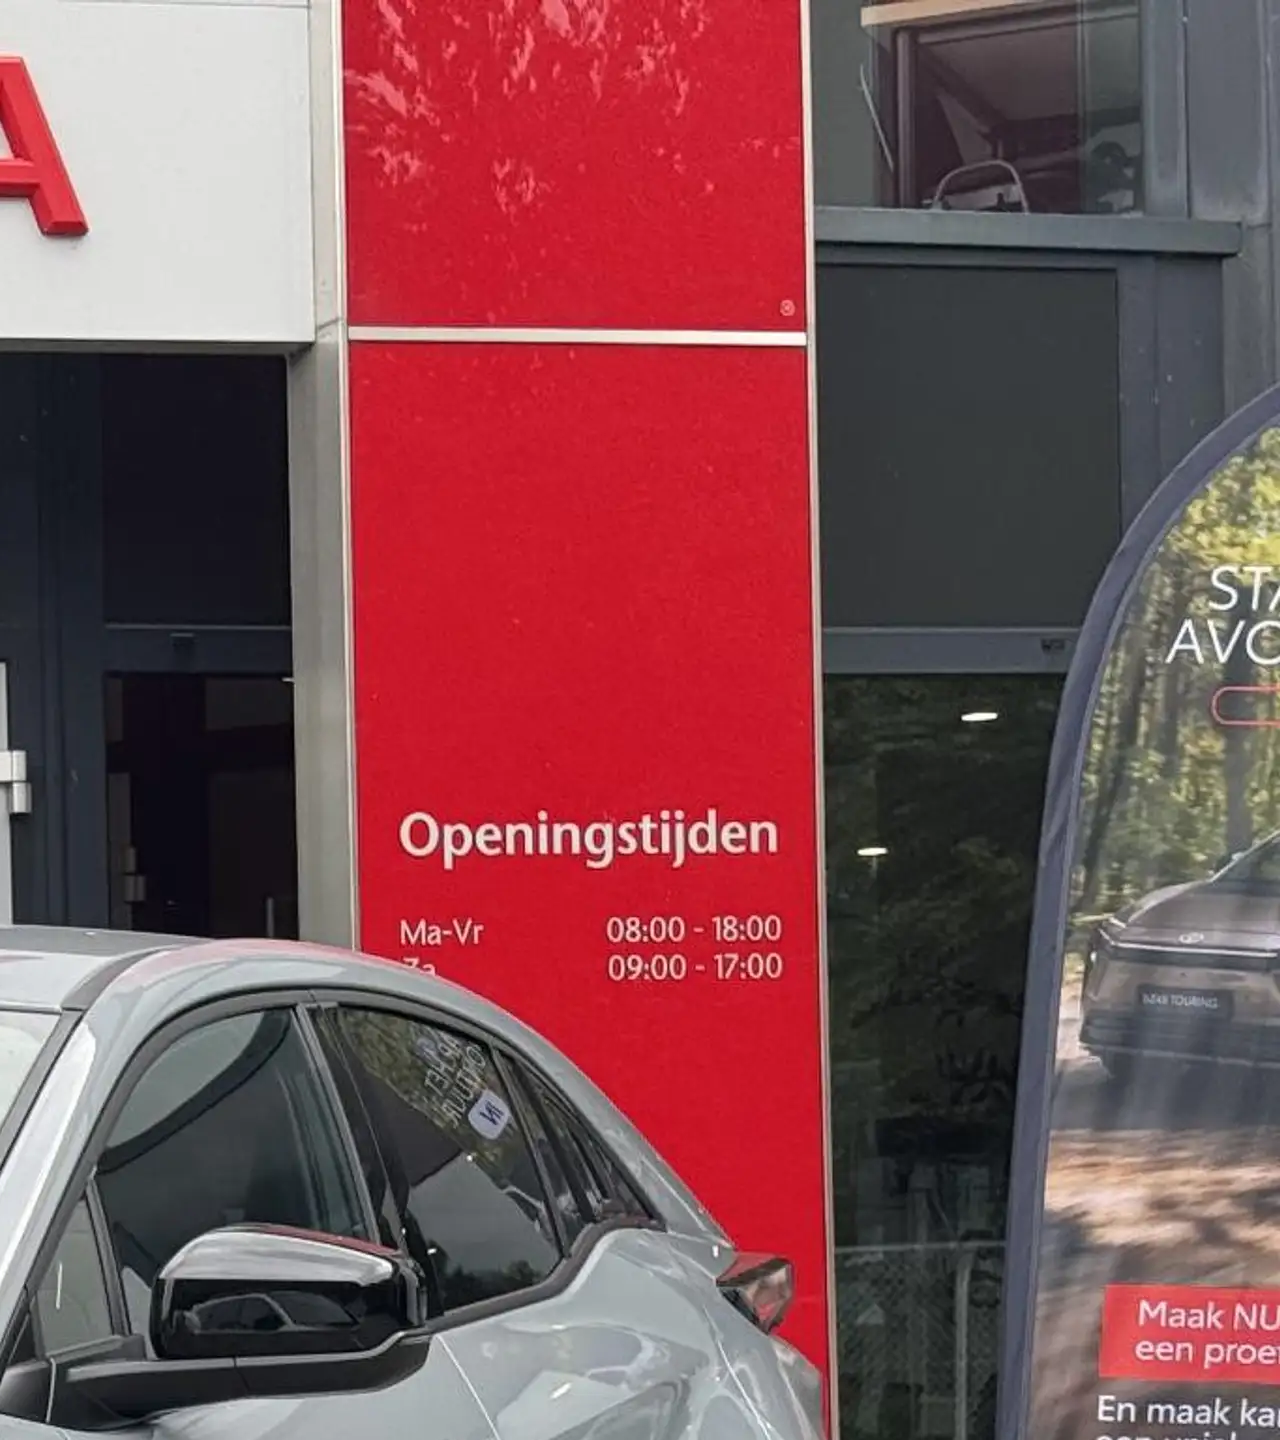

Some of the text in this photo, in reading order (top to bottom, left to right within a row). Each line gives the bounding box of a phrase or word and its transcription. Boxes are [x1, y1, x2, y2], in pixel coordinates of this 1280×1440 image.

[399, 808, 778, 869] Openingstijden
[400, 917, 484, 946] Ma-Vr
[606, 916, 685, 943] 08:00
[712, 914, 782, 942] 18:00
[608, 953, 687, 981] 09:00
[714, 952, 782, 980] 17:00
[1139, 1300, 1280, 1332] Maak NU
[1135, 1339, 1280, 1370] een proe
[1097, 1395, 1280, 1427] En maak ka
